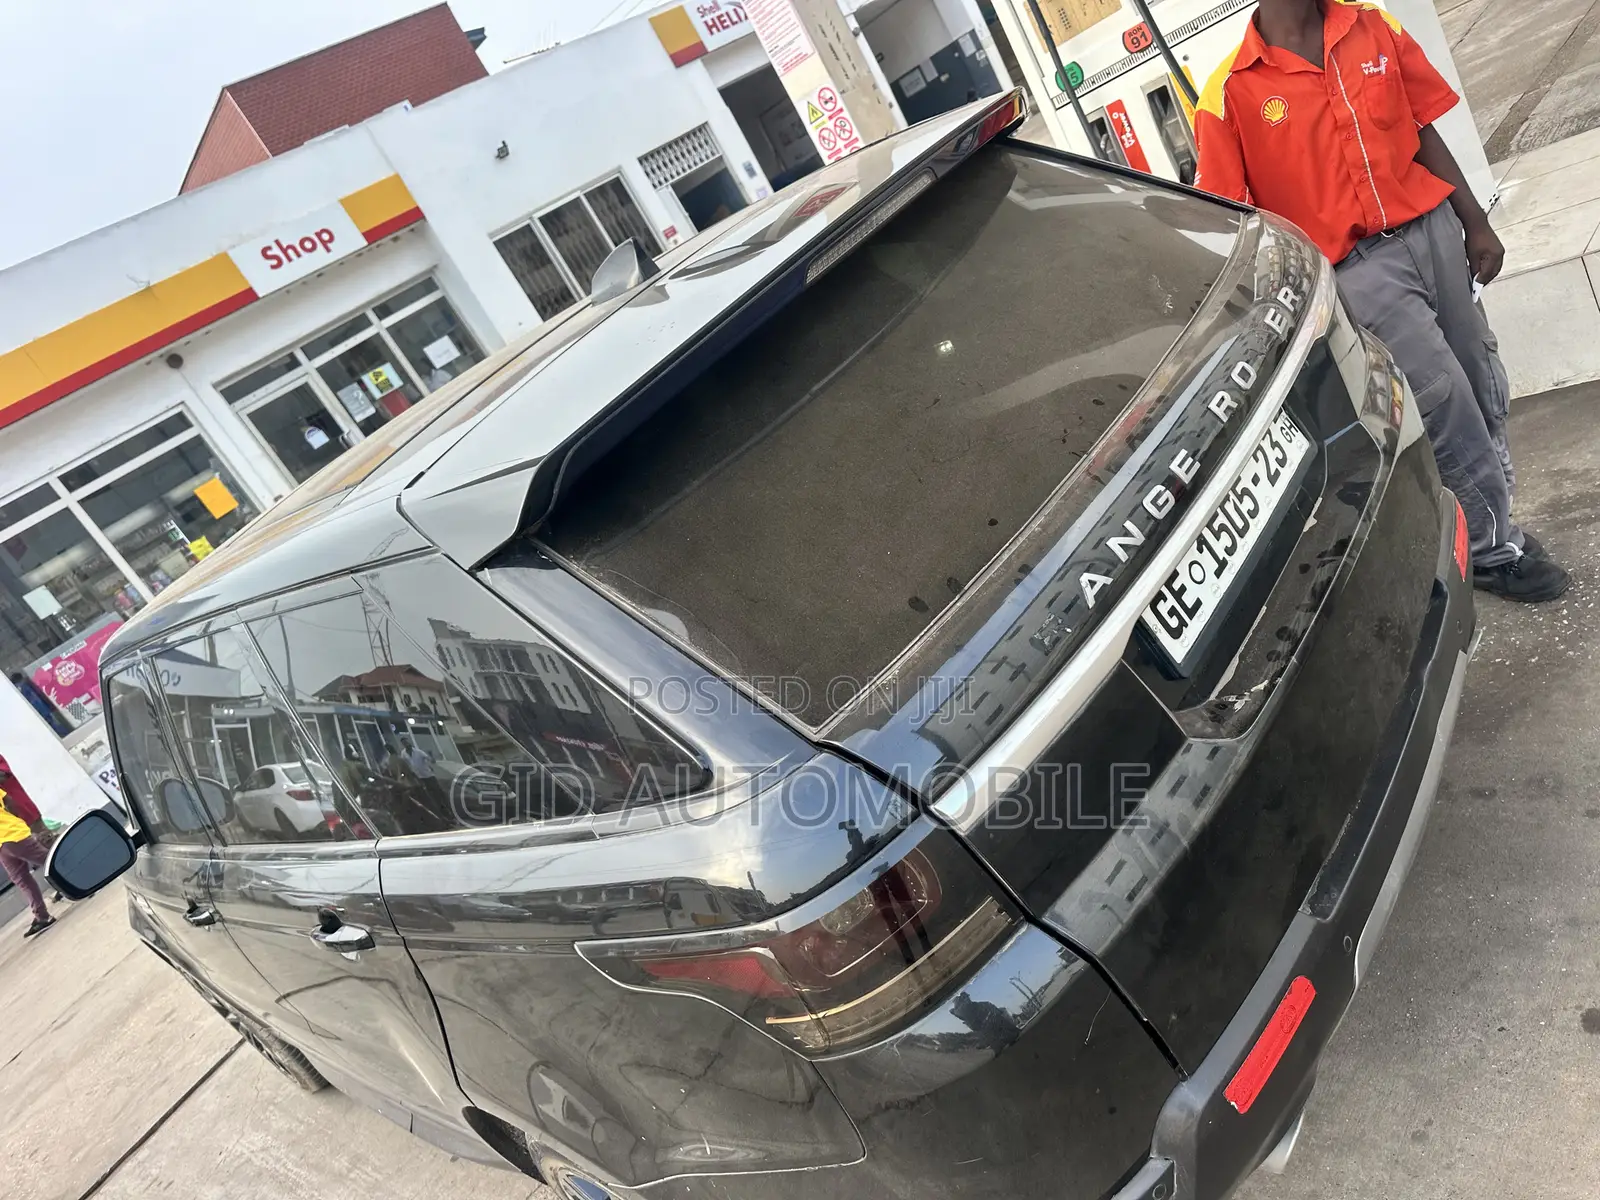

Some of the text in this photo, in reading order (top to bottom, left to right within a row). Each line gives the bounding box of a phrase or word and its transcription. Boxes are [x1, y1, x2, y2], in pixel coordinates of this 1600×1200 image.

[697, 0, 721, 18] Shell
[1128, 26, 1143, 38] RON
[1131, 31, 1149, 49] 91
[260, 228, 335, 270] Shop
[1149, 568, 1203, 641] GE
[1280, 416, 1300, 445] GH
